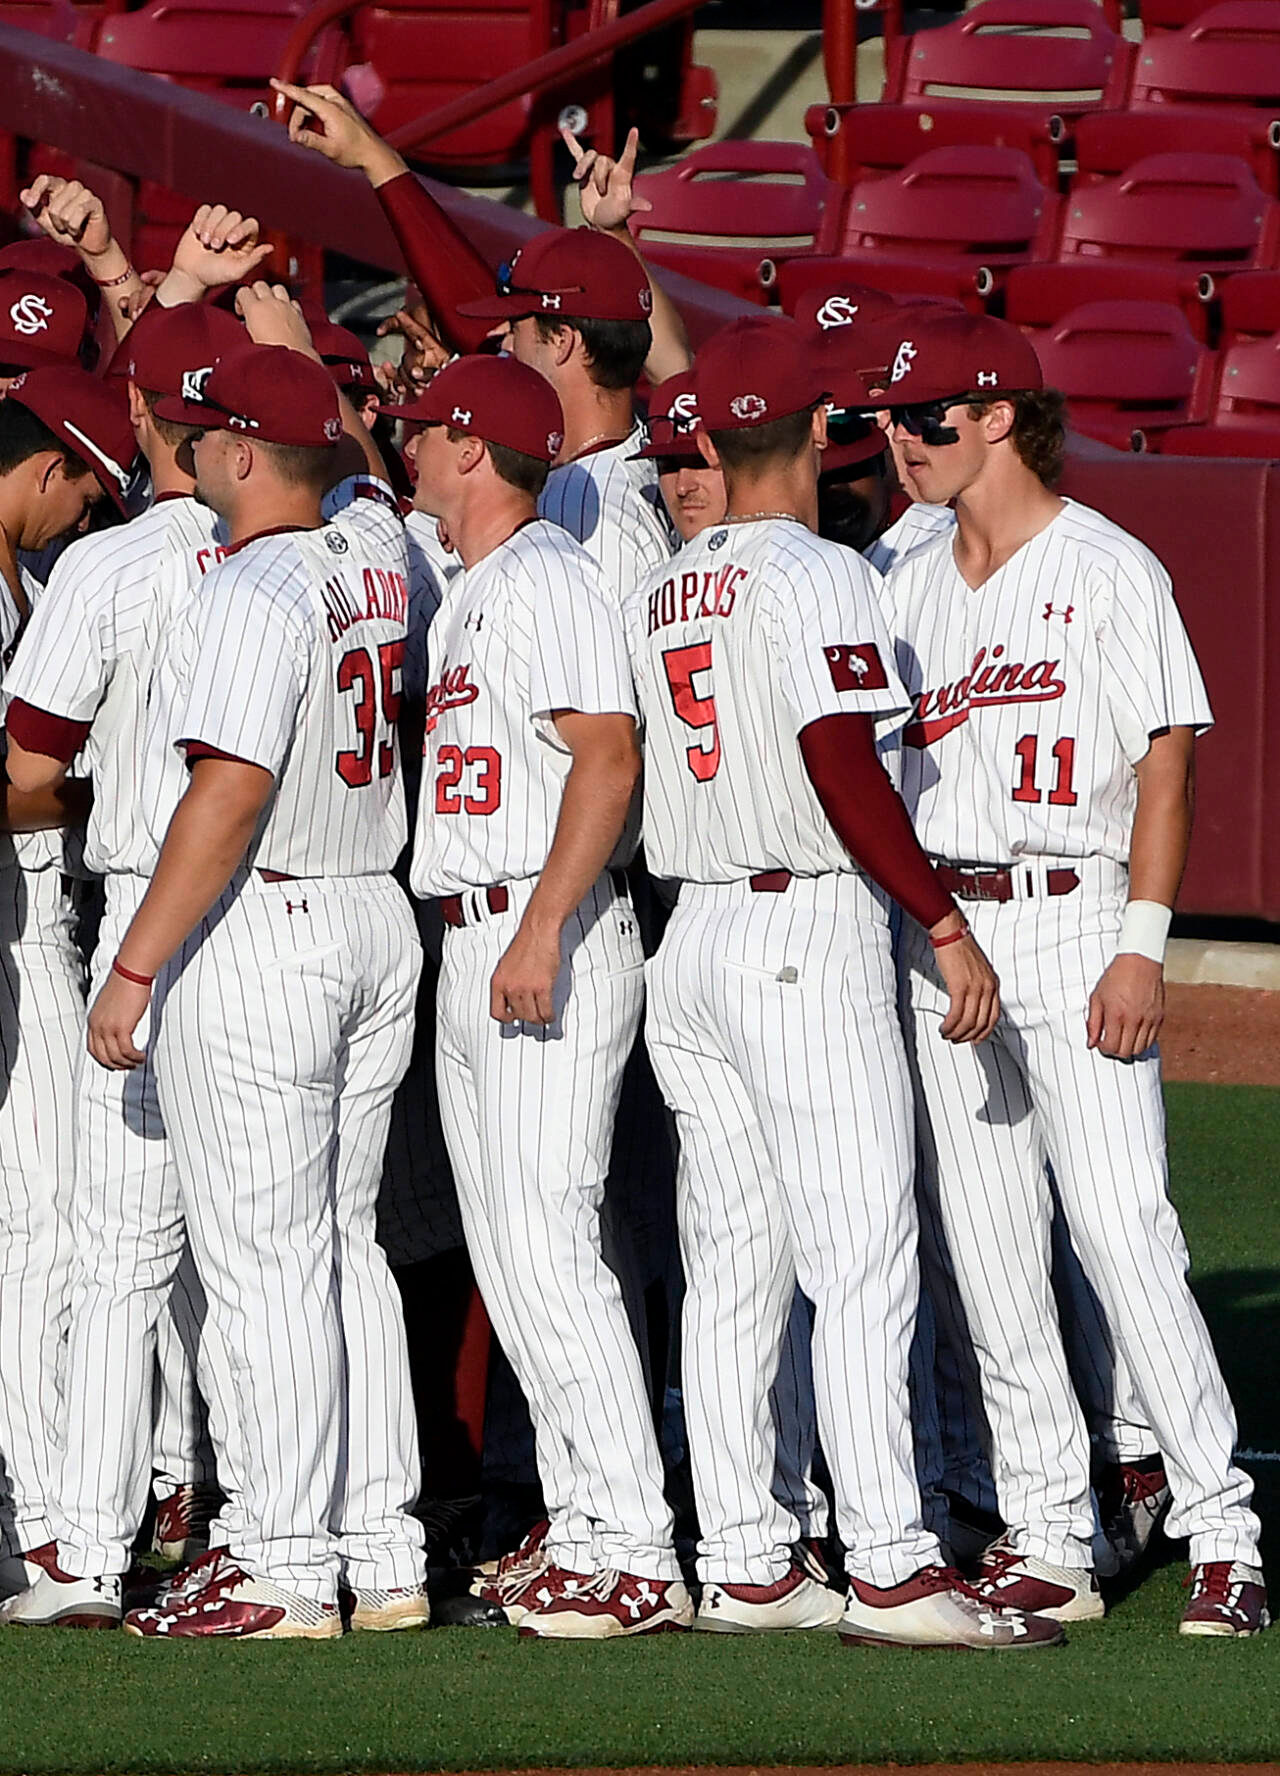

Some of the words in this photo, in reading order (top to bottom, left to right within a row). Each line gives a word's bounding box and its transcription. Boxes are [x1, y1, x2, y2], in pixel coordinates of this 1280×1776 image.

[335, 638, 407, 789] 35
[661, 641, 721, 783] 5
[907, 643, 1067, 728] arolina
[435, 745, 502, 816] 23
[1011, 734, 1079, 807] 11
